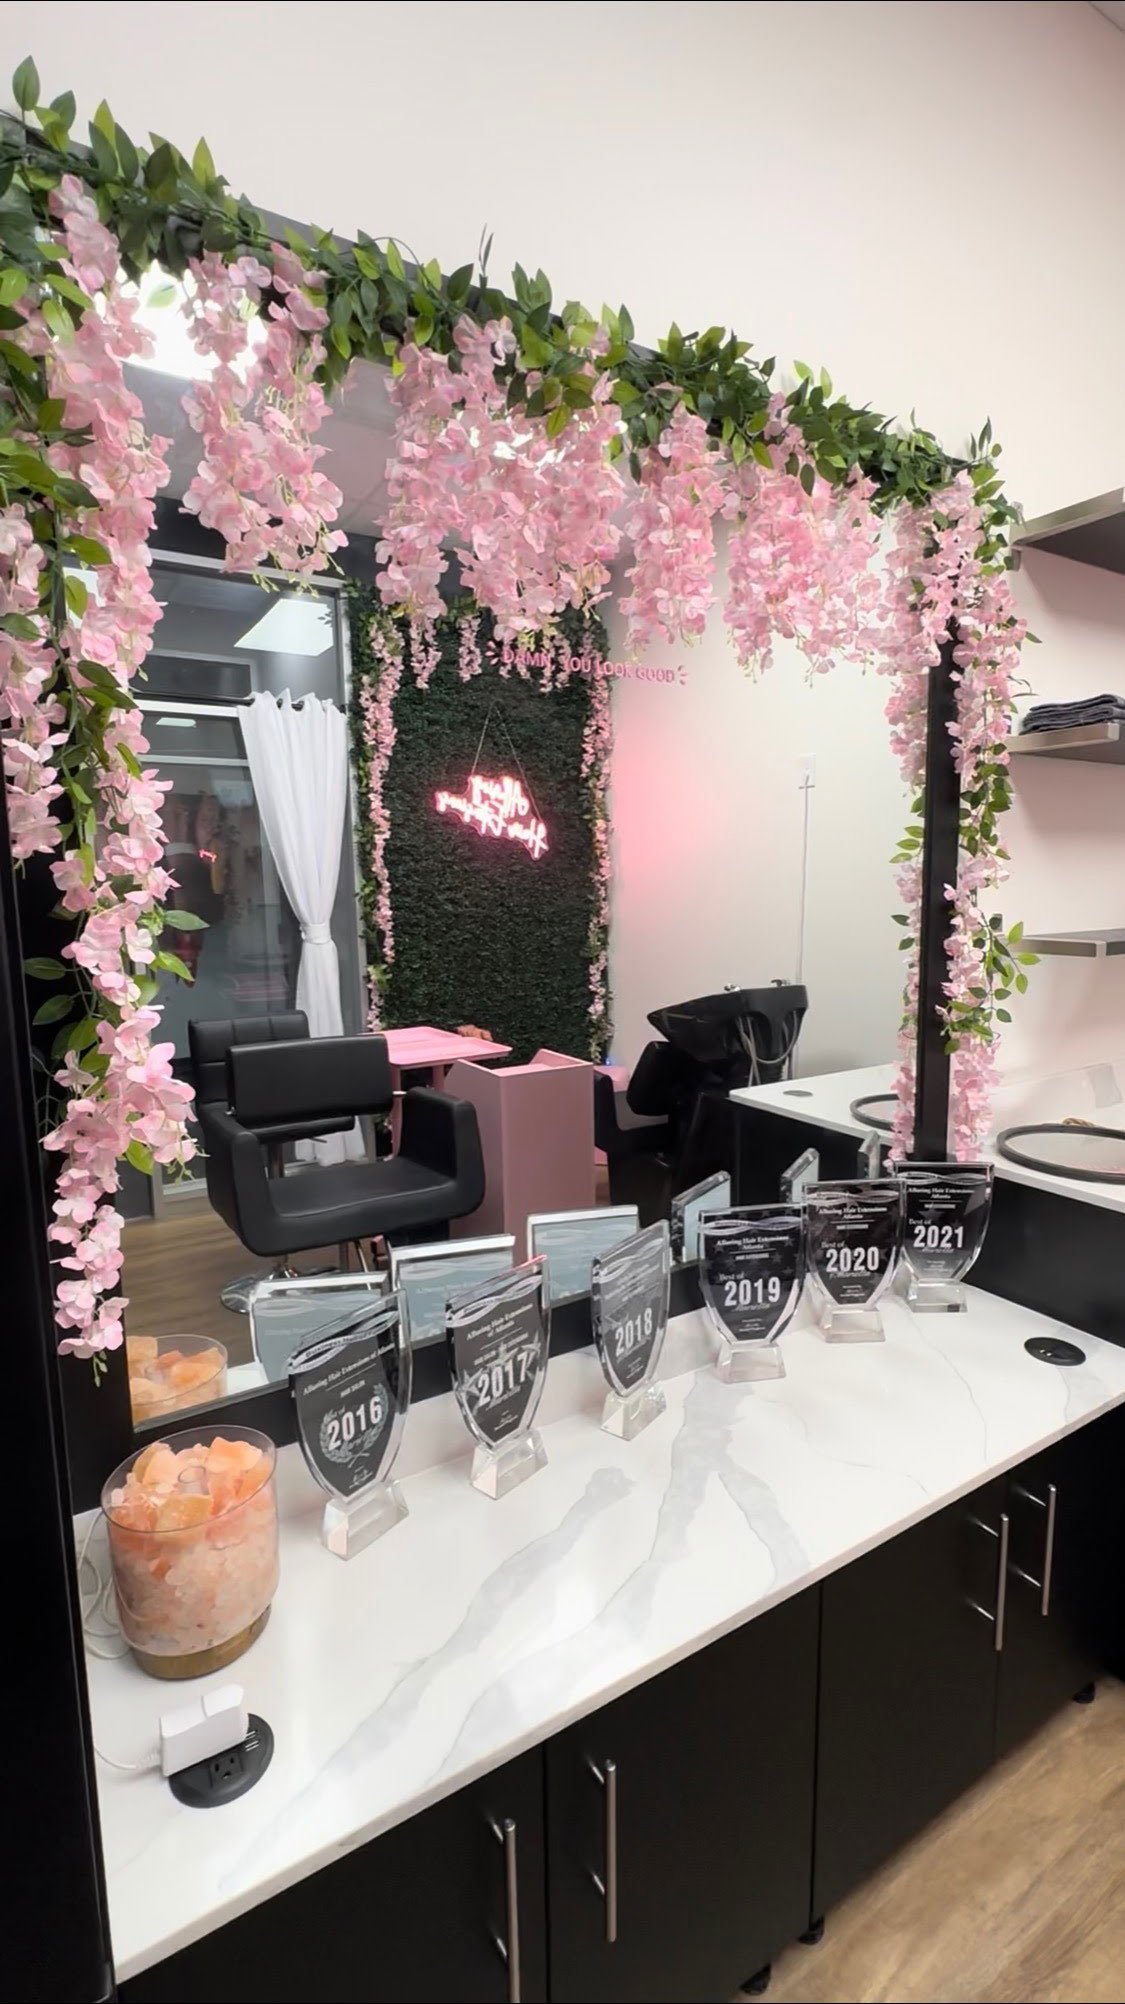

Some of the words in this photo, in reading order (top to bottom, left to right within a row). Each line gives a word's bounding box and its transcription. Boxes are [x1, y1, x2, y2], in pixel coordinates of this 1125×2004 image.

[562, 656, 591, 673] YOU
[596, 660, 631, 678] LOOK
[635, 666, 675, 683] GOOD
[821, 1241, 836, 1249] Best
[837, 1240, 846, 1248] of
[913, 1225, 964, 1248] 2021
[826, 1246, 880, 1272] 2020
[718, 1272, 735, 1281] Best
[736, 1270, 745, 1279] of
[724, 1276, 780, 1307] 2019
[615, 1307, 652, 1357] 2018
[478, 1350, 528, 1407] 2017
[327, 1395, 382, 1451] 2016
